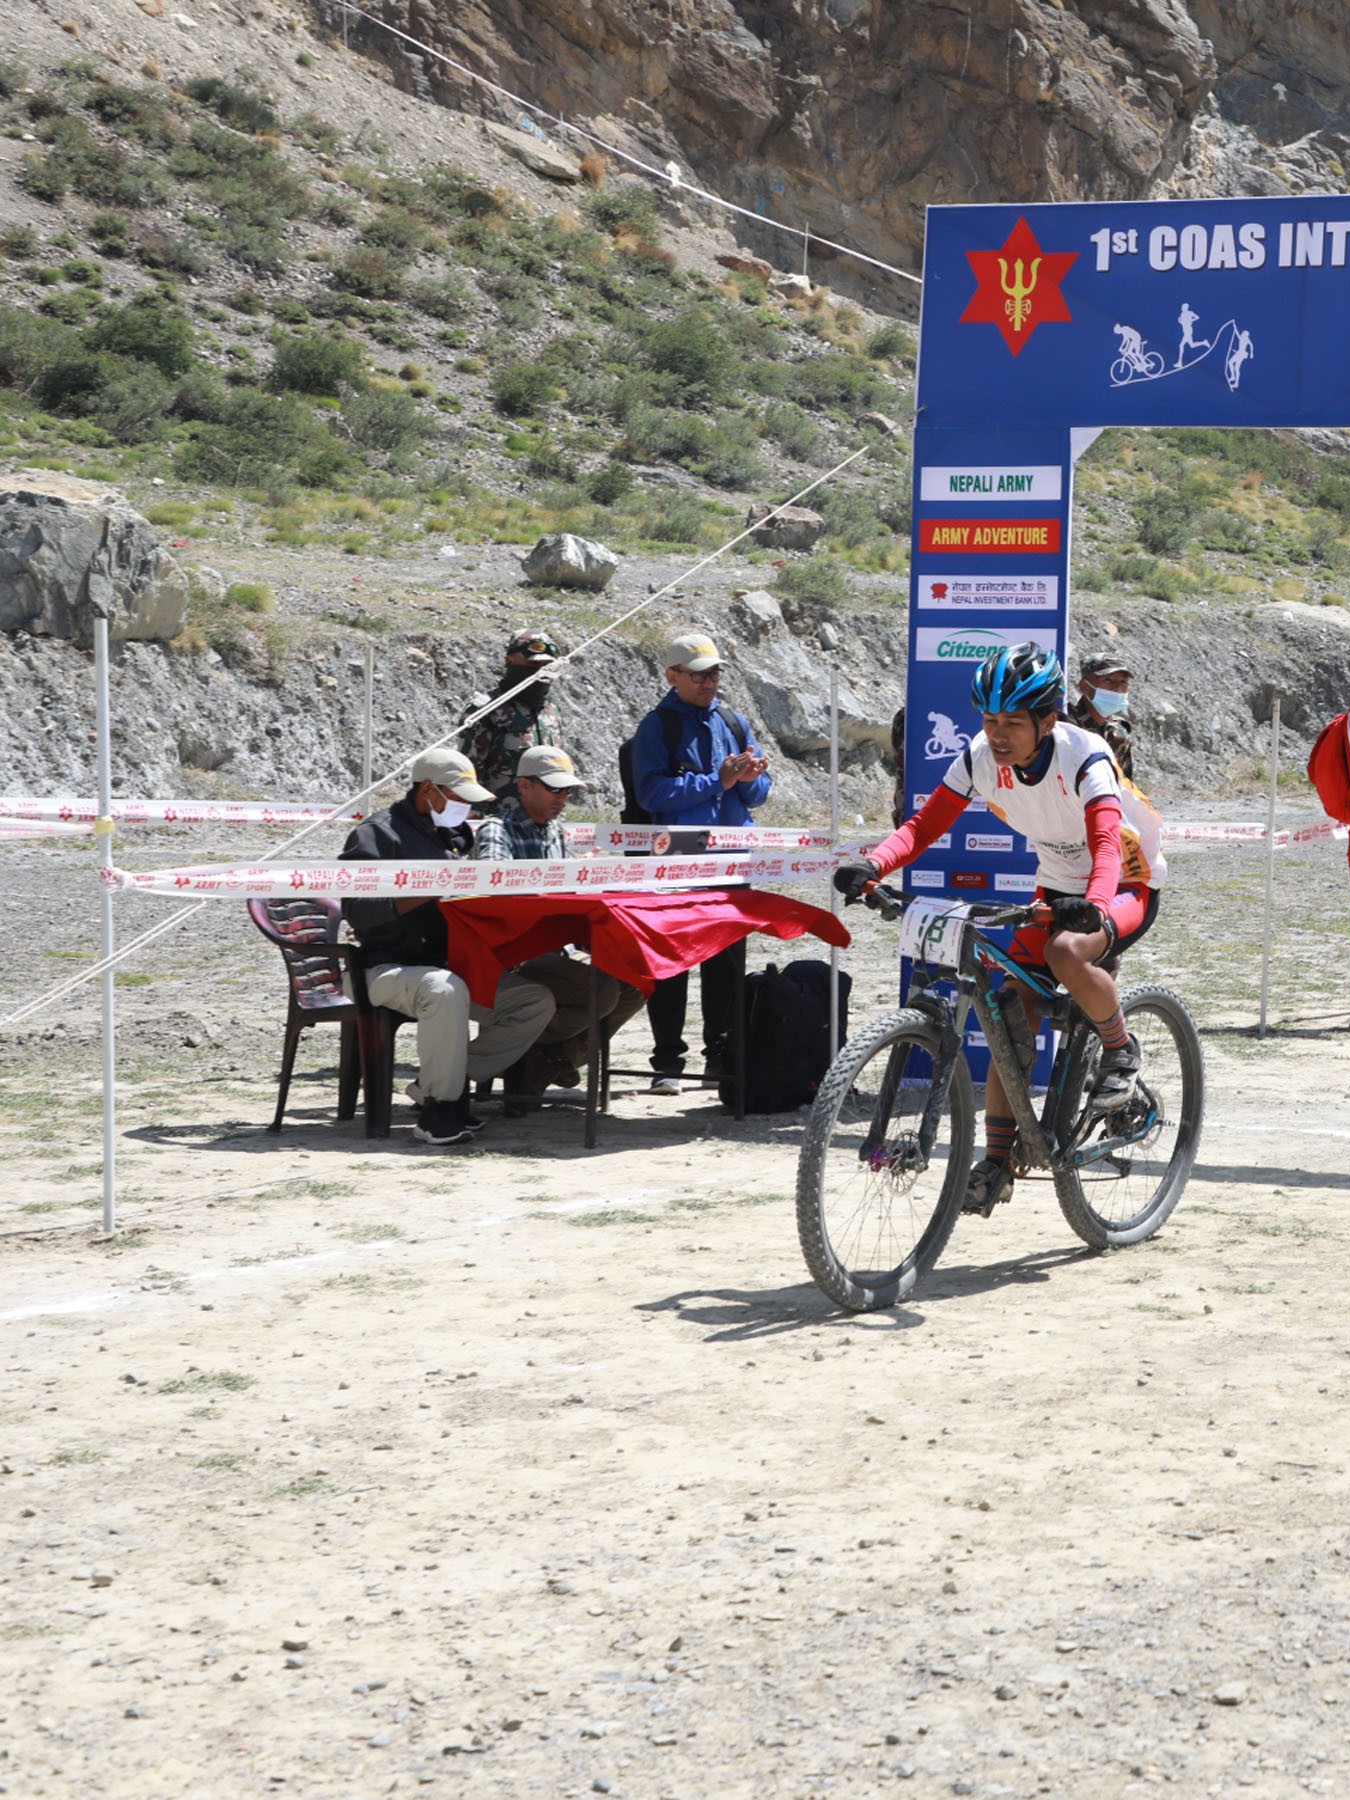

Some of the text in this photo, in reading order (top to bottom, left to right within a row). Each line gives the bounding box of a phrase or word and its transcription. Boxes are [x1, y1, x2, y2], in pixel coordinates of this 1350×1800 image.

[1090, 227, 1138, 272] 1st
[1149, 223, 1267, 271] COAS
[950, 474, 1034, 493] NEPALI ARMY
[932, 527, 1048, 545] ARMY ADVENTURE
[997, 766, 1014, 789] 18
[411, 870, 436, 879] NEPALI
[505, 868, 528, 878] NEPALI
[194, 881, 223, 890] ARMY
[308, 881, 333, 891] ARMY
[412, 880, 433, 889] ARMY
[505, 878, 525, 887] ARMY
[918, 914, 948, 943] 18
